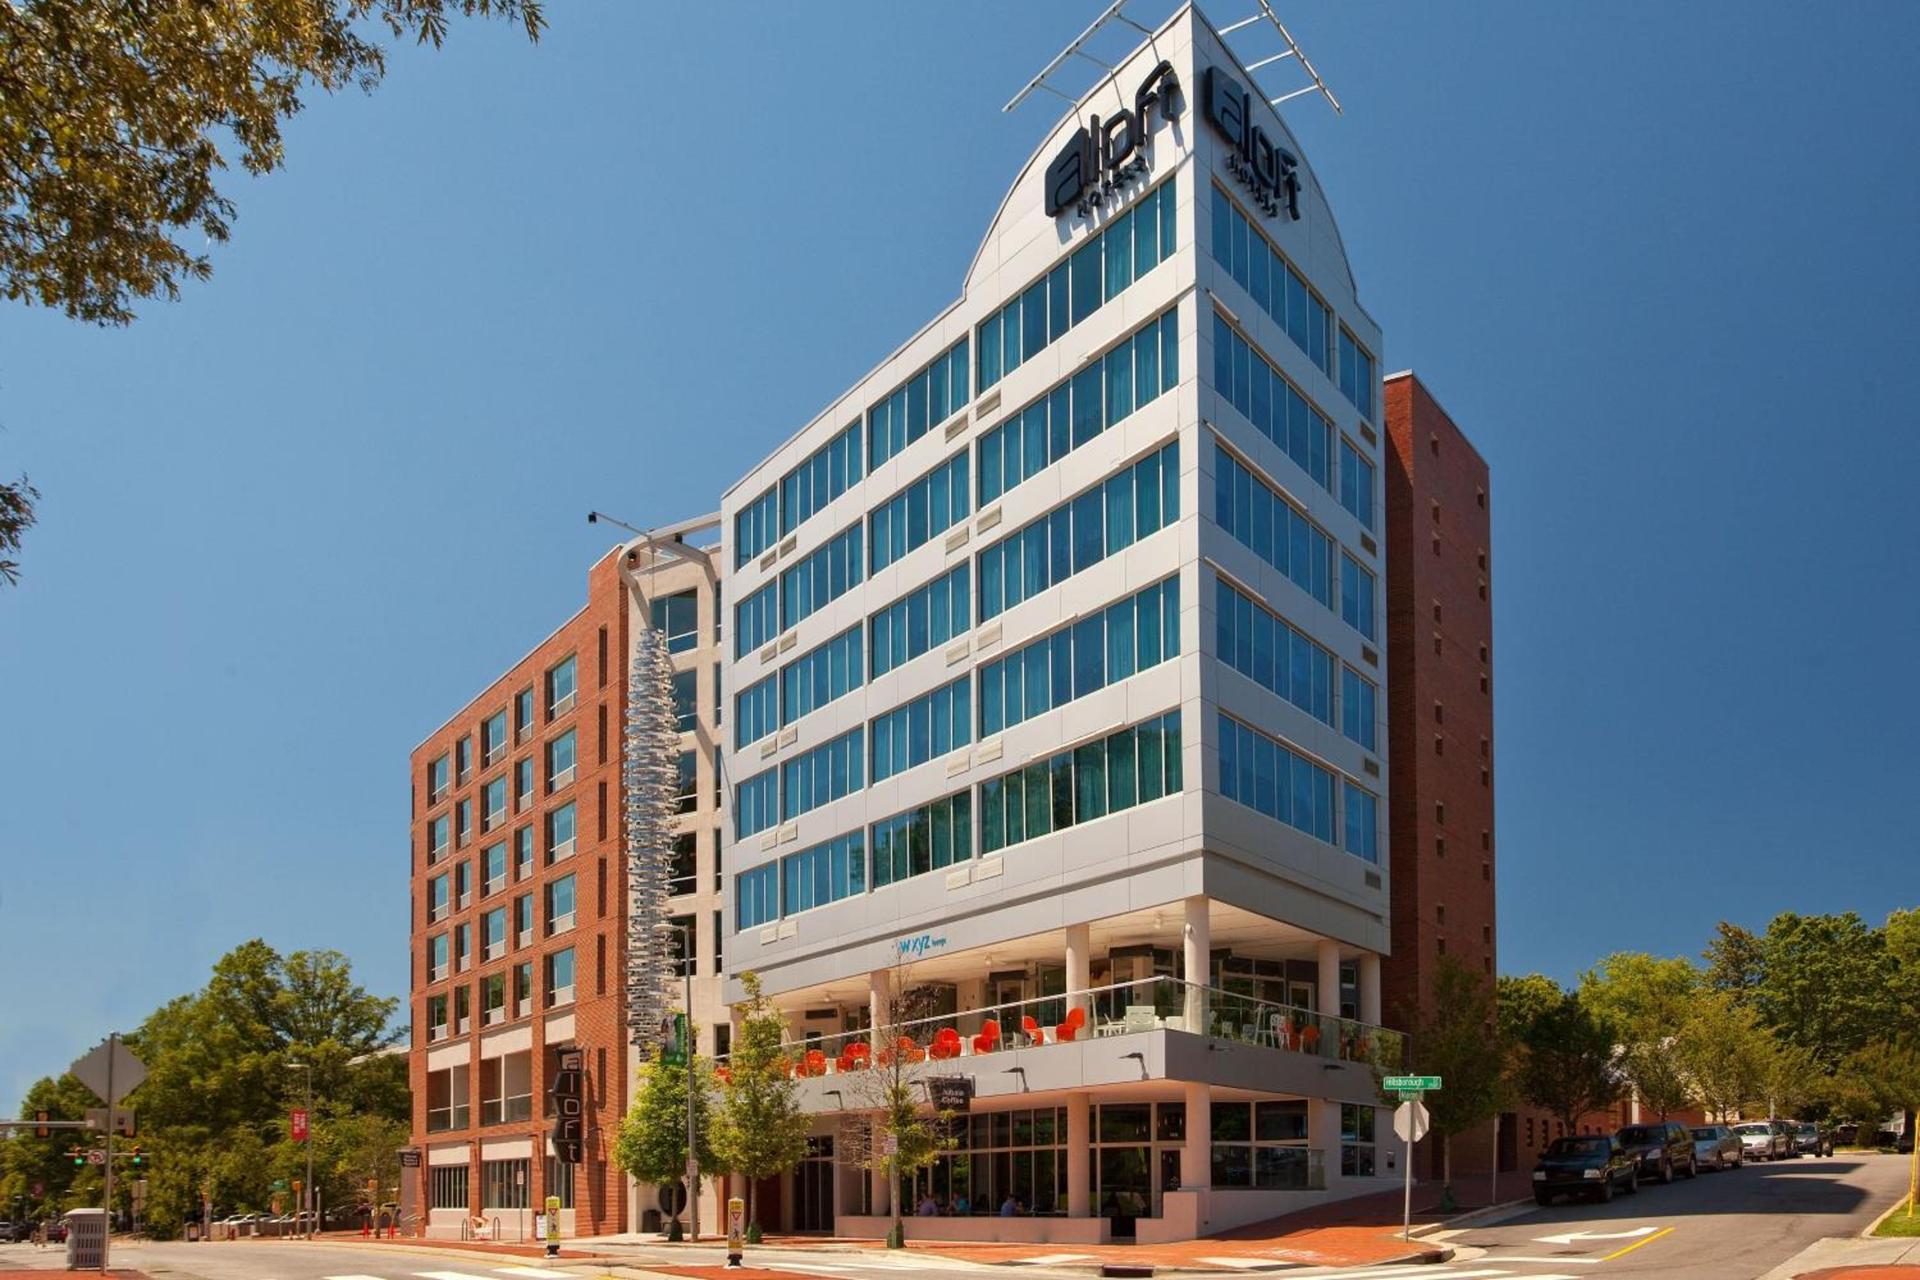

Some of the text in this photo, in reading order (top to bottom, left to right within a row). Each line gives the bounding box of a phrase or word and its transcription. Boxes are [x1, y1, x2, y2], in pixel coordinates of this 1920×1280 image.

[1045, 60, 1180, 217] aloft
[1206, 66, 1301, 221] aloft
[562, 1050, 581, 1162] aloft
